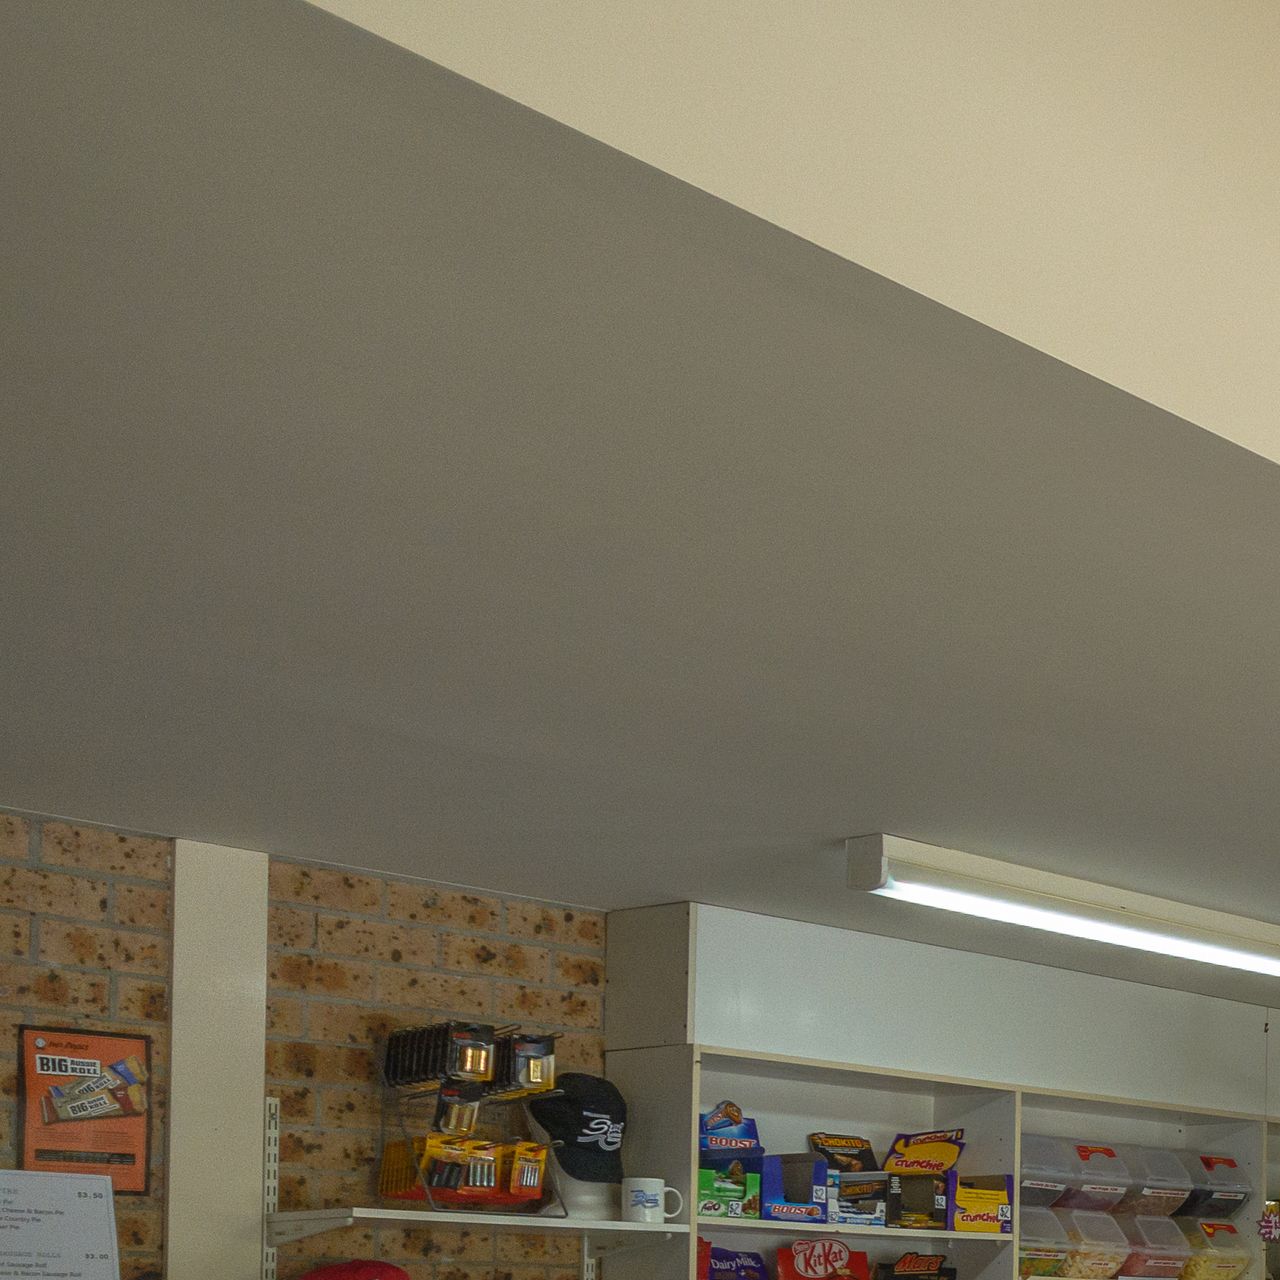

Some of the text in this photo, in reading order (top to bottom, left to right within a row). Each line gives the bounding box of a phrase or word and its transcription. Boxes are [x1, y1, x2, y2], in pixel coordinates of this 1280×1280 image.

[38, 1056, 69, 1073] BIG
[71, 1067, 99, 1075] ROLL
[70, 1102, 88, 1115] BIG
[709, 1136, 755, 1148] BOOST
[895, 1159, 944, 1171] crunchie
[78, 1191, 103, 1199] $3.50
[771, 1204, 809, 1214] BOOST
[711, 1257, 760, 1271] Dairy Milk
